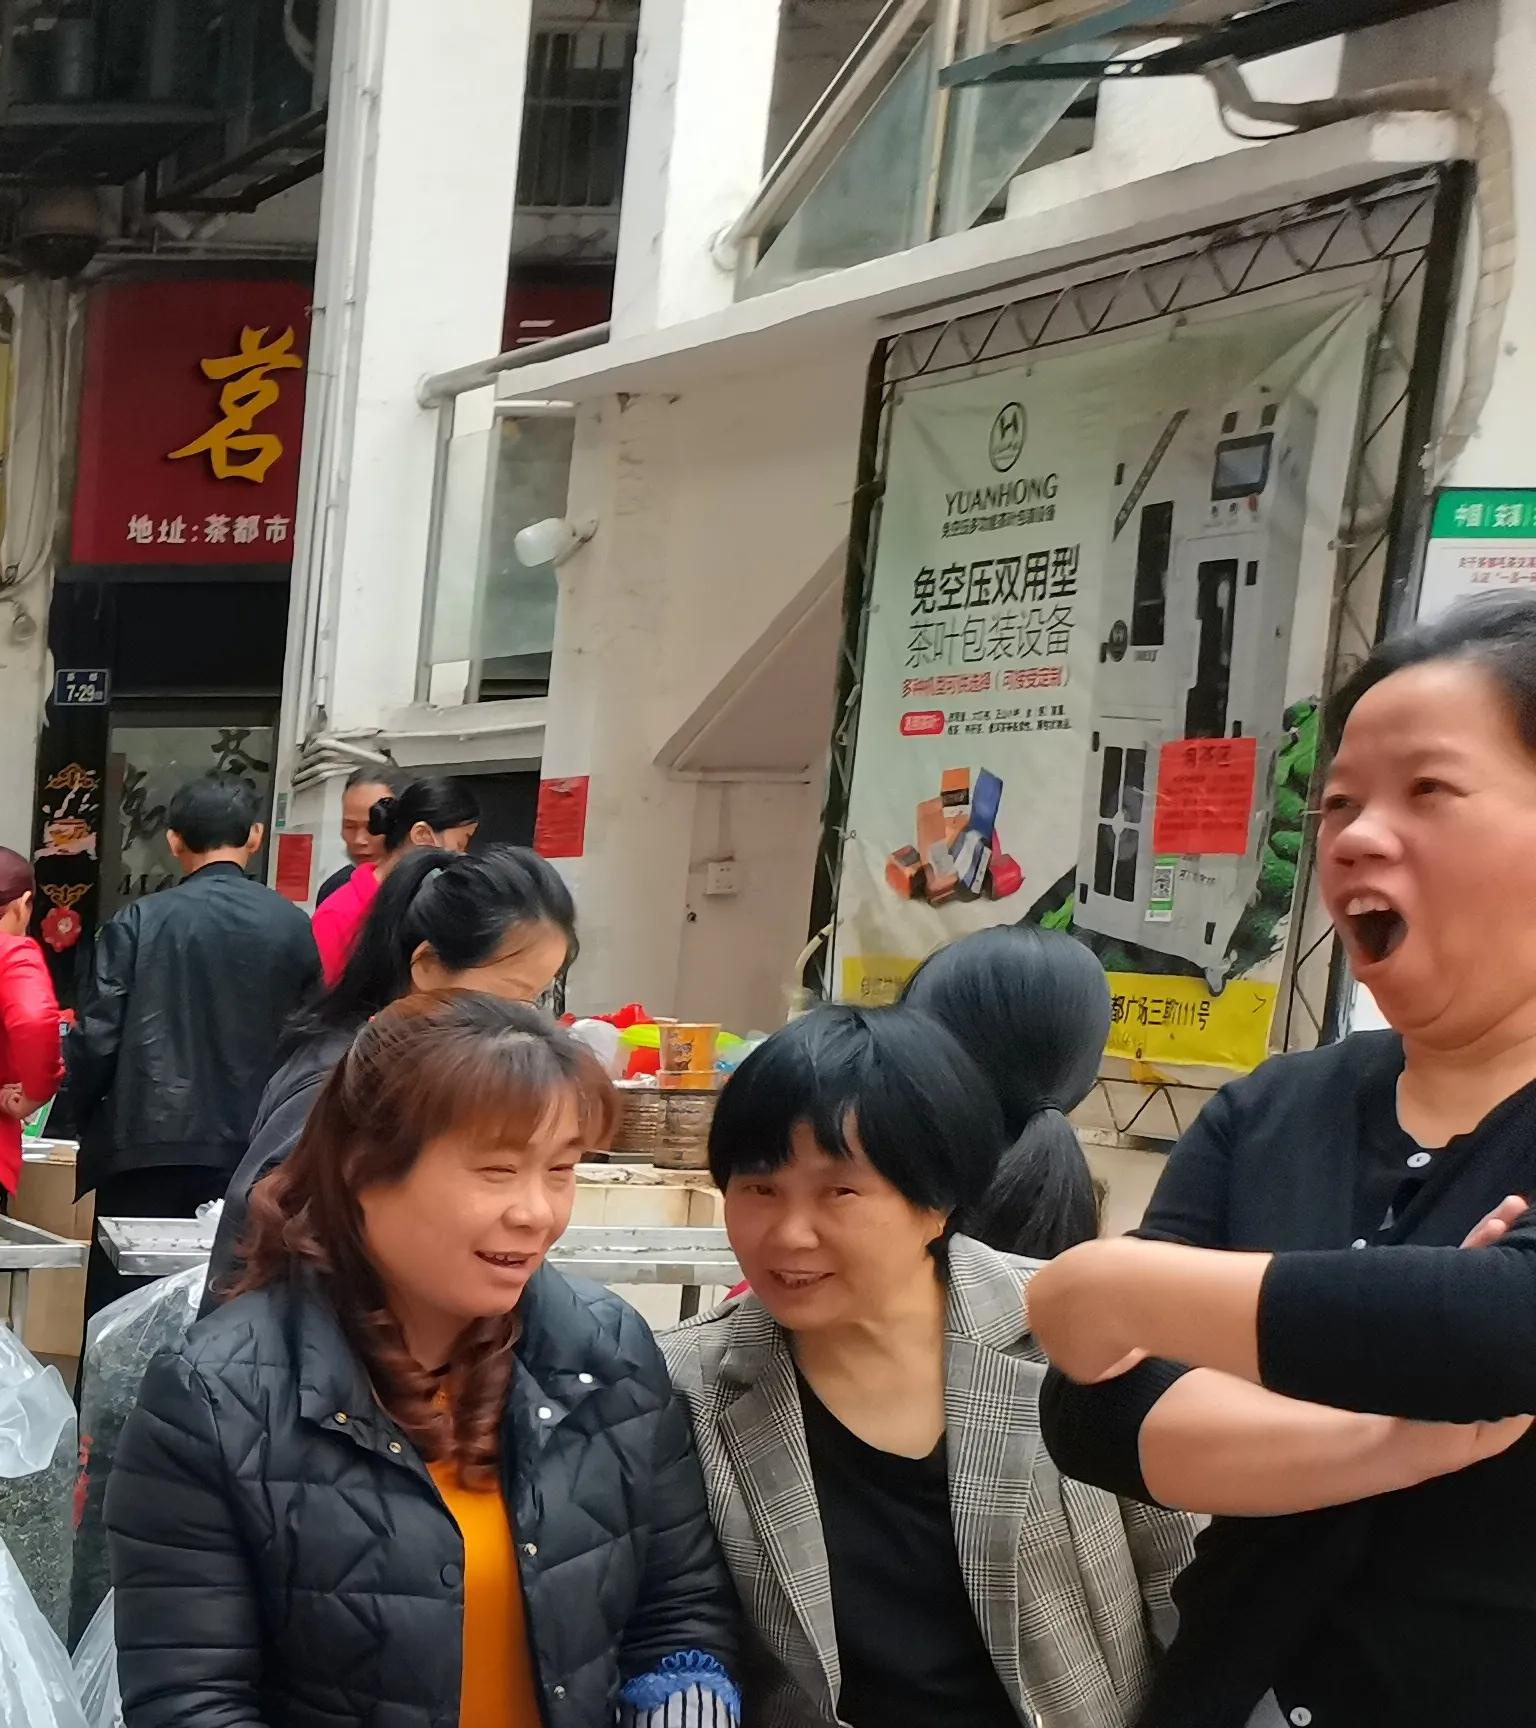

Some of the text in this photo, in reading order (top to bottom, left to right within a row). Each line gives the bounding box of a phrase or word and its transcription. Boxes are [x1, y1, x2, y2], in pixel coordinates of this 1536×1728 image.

[167, 325, 304, 484] 茗
[944, 473, 1060, 516] YUANHONG
[910, 543, 1081, 617] 免空压双用型
[905, 603, 1077, 669] 茶叶包装设备
